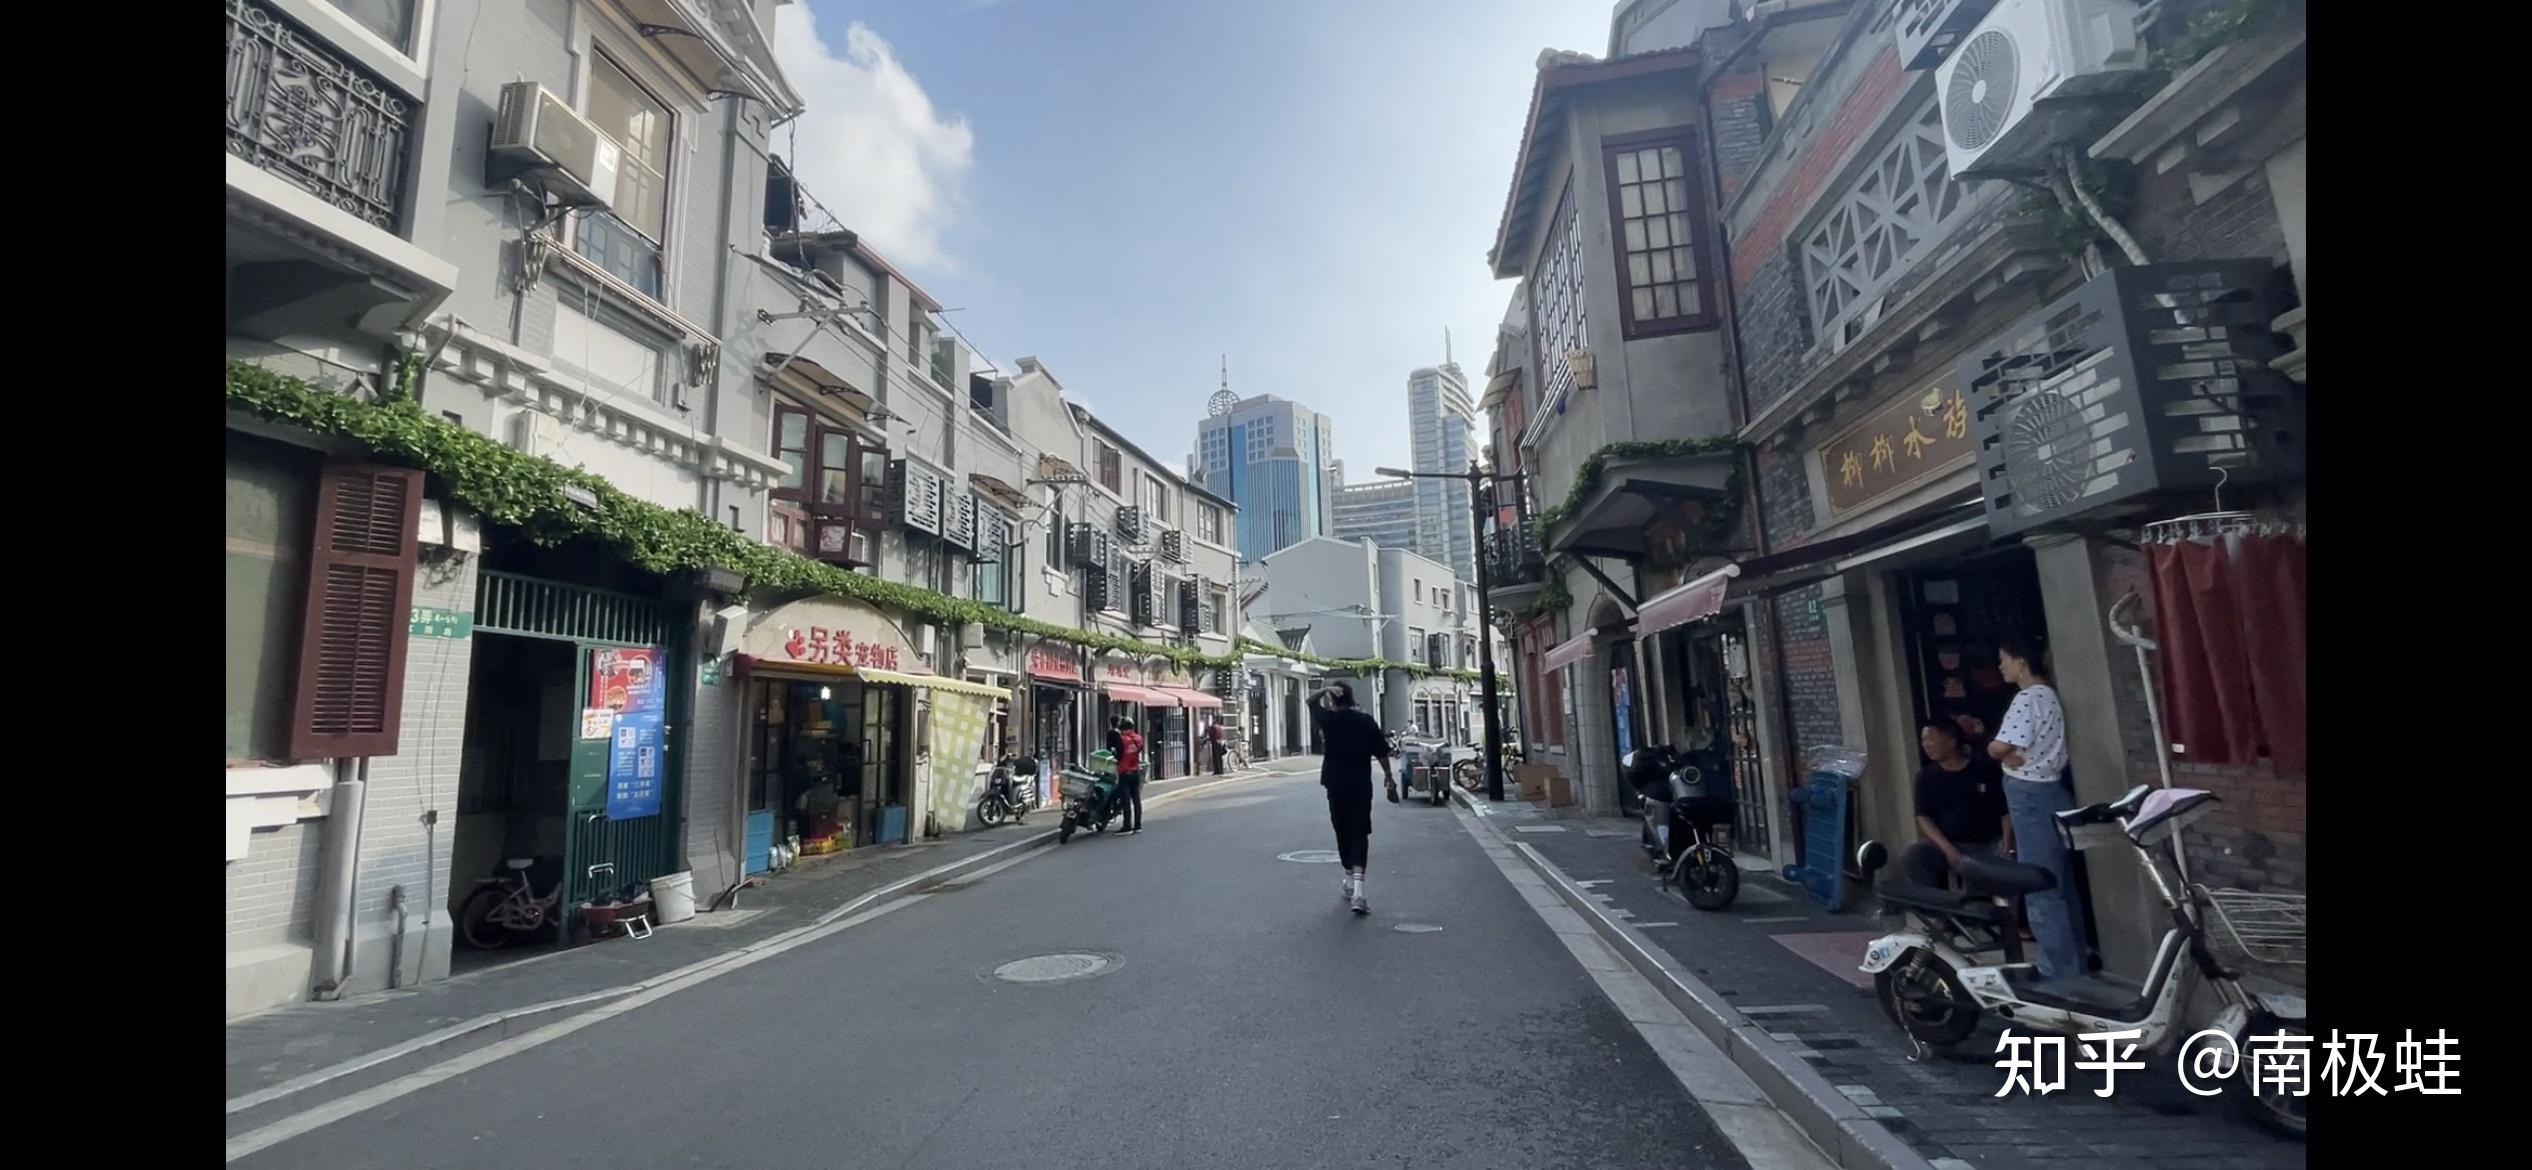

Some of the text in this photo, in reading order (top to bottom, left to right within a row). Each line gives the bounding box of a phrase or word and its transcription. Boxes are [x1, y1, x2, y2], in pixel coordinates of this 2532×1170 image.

[808, 626, 898, 671] 另类宠物店
